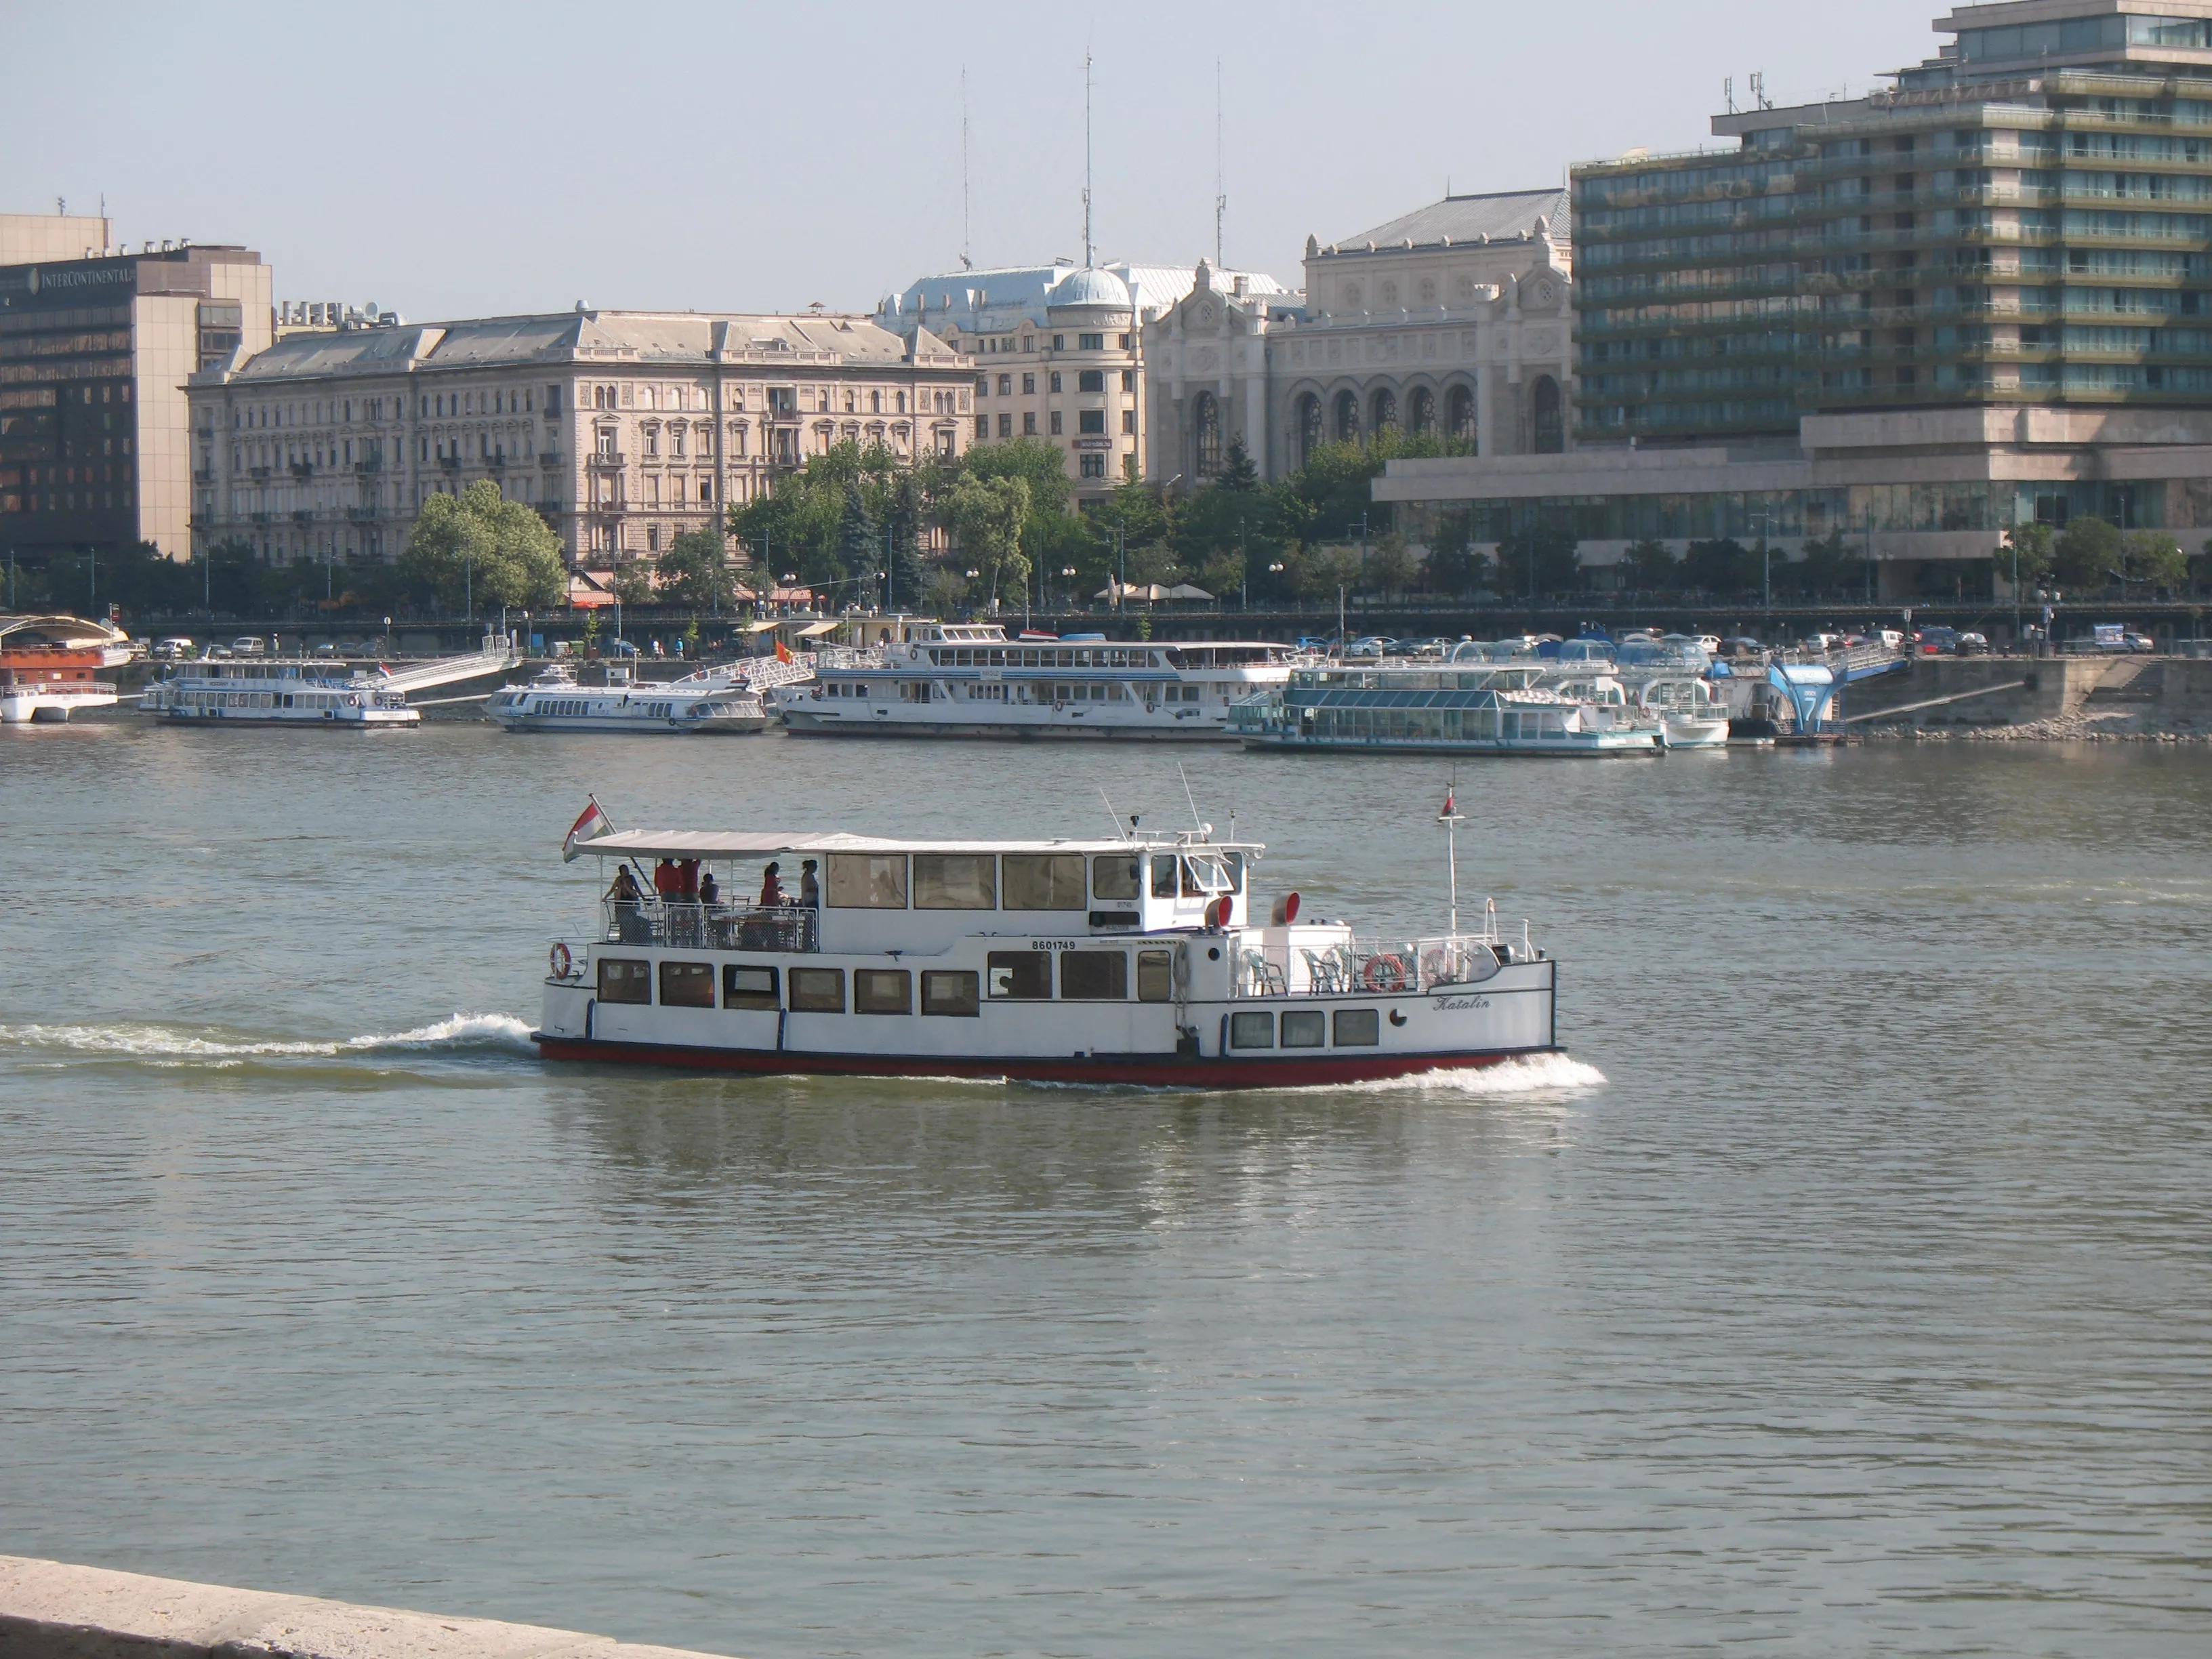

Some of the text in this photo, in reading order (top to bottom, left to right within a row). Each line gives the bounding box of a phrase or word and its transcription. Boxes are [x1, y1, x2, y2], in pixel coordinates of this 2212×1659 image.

[1805, 697, 1817, 722] 7
[1032, 941, 1076, 949] 8601749
[1433, 995, 1490, 1011] Katalin
